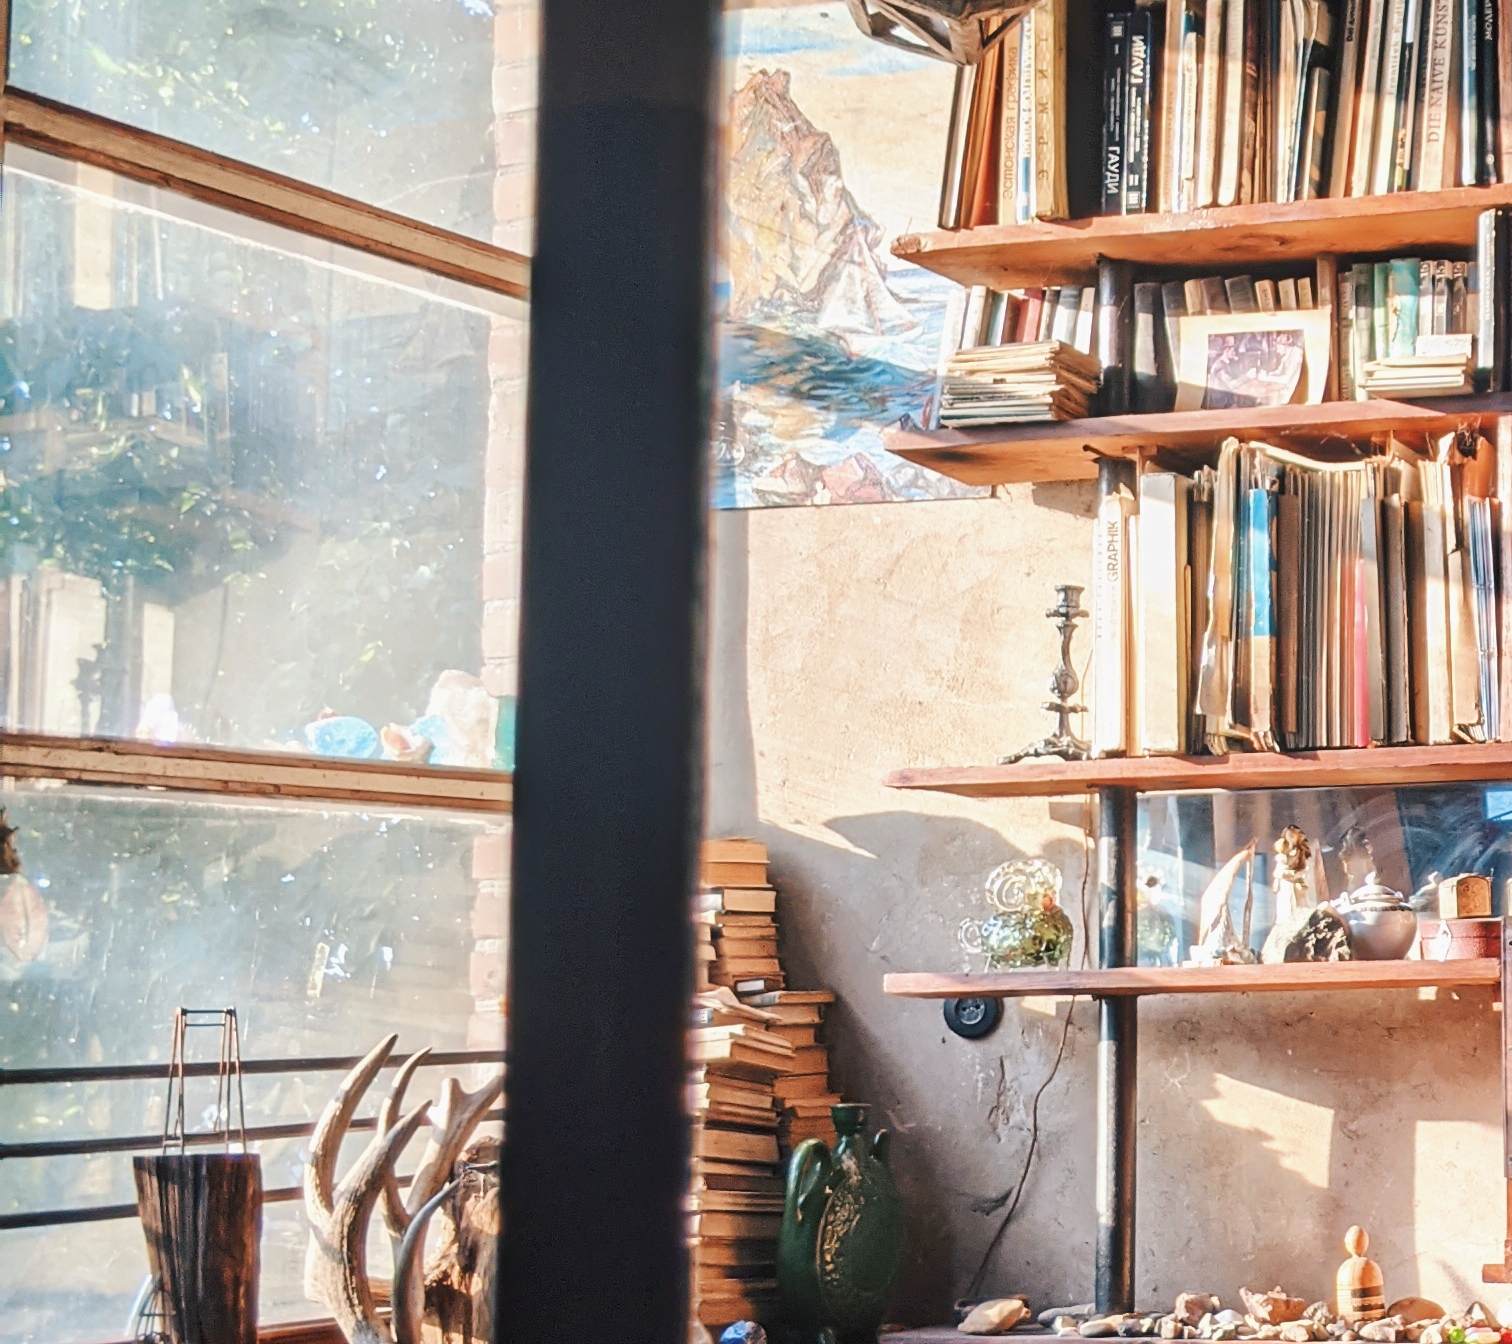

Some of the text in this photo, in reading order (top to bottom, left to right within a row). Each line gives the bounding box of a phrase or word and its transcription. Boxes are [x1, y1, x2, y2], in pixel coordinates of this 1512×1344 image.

[1005, 46, 1019, 110] графика
[1130, 35, 1146, 85] ГАУДИ
[1429, 57, 1446, 108] NAIVE
[1428, 112, 1441, 143] DIE
[1106, 146, 1120, 194] ГАУДИ
[1106, 520, 1119, 582] GRAPHIK
